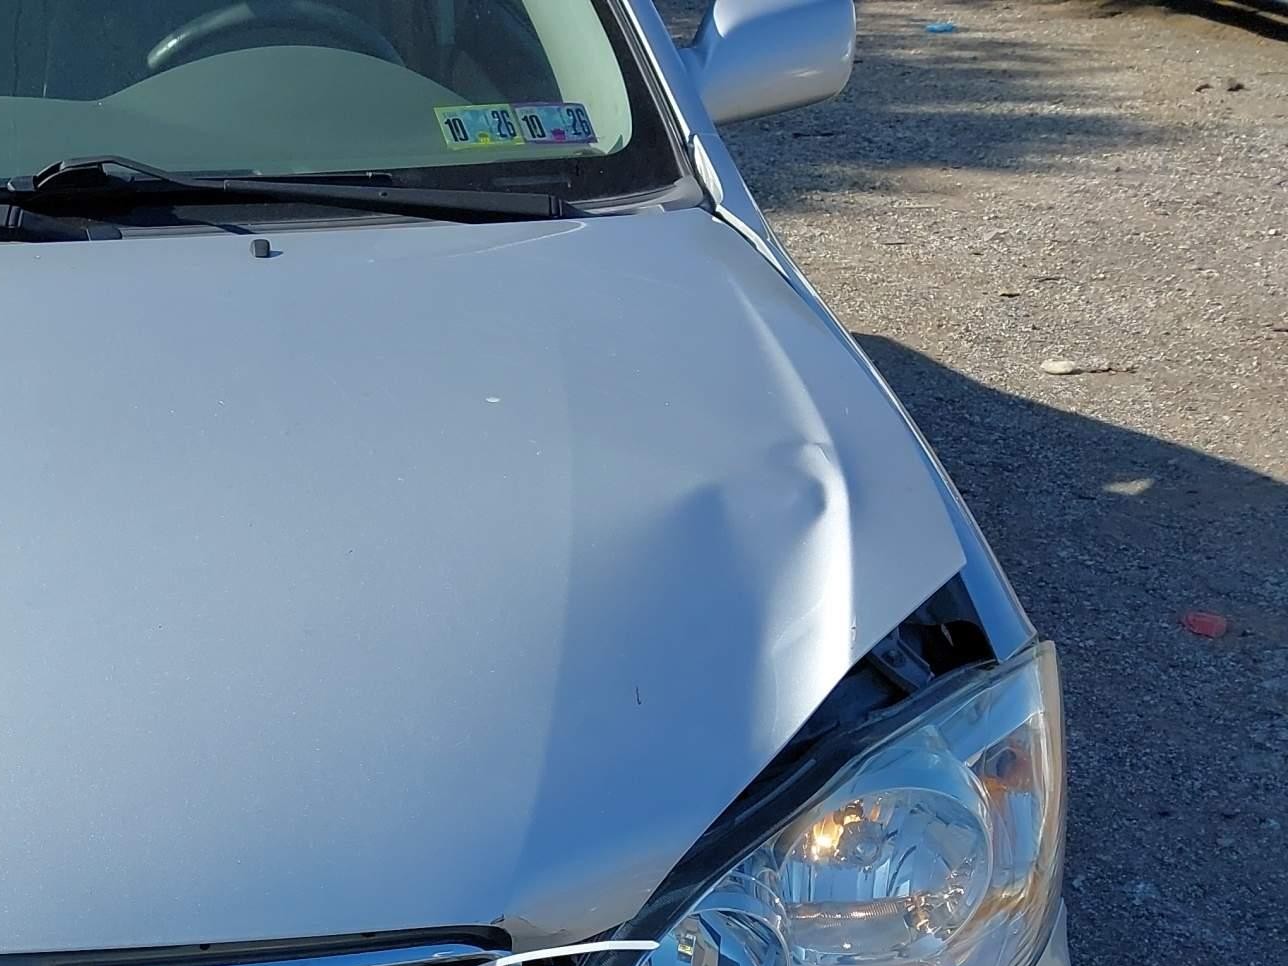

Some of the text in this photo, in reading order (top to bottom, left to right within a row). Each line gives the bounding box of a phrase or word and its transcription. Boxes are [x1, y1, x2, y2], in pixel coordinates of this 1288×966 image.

[444, 109, 517, 142] 10 26
[521, 107, 592, 140] 10 26
